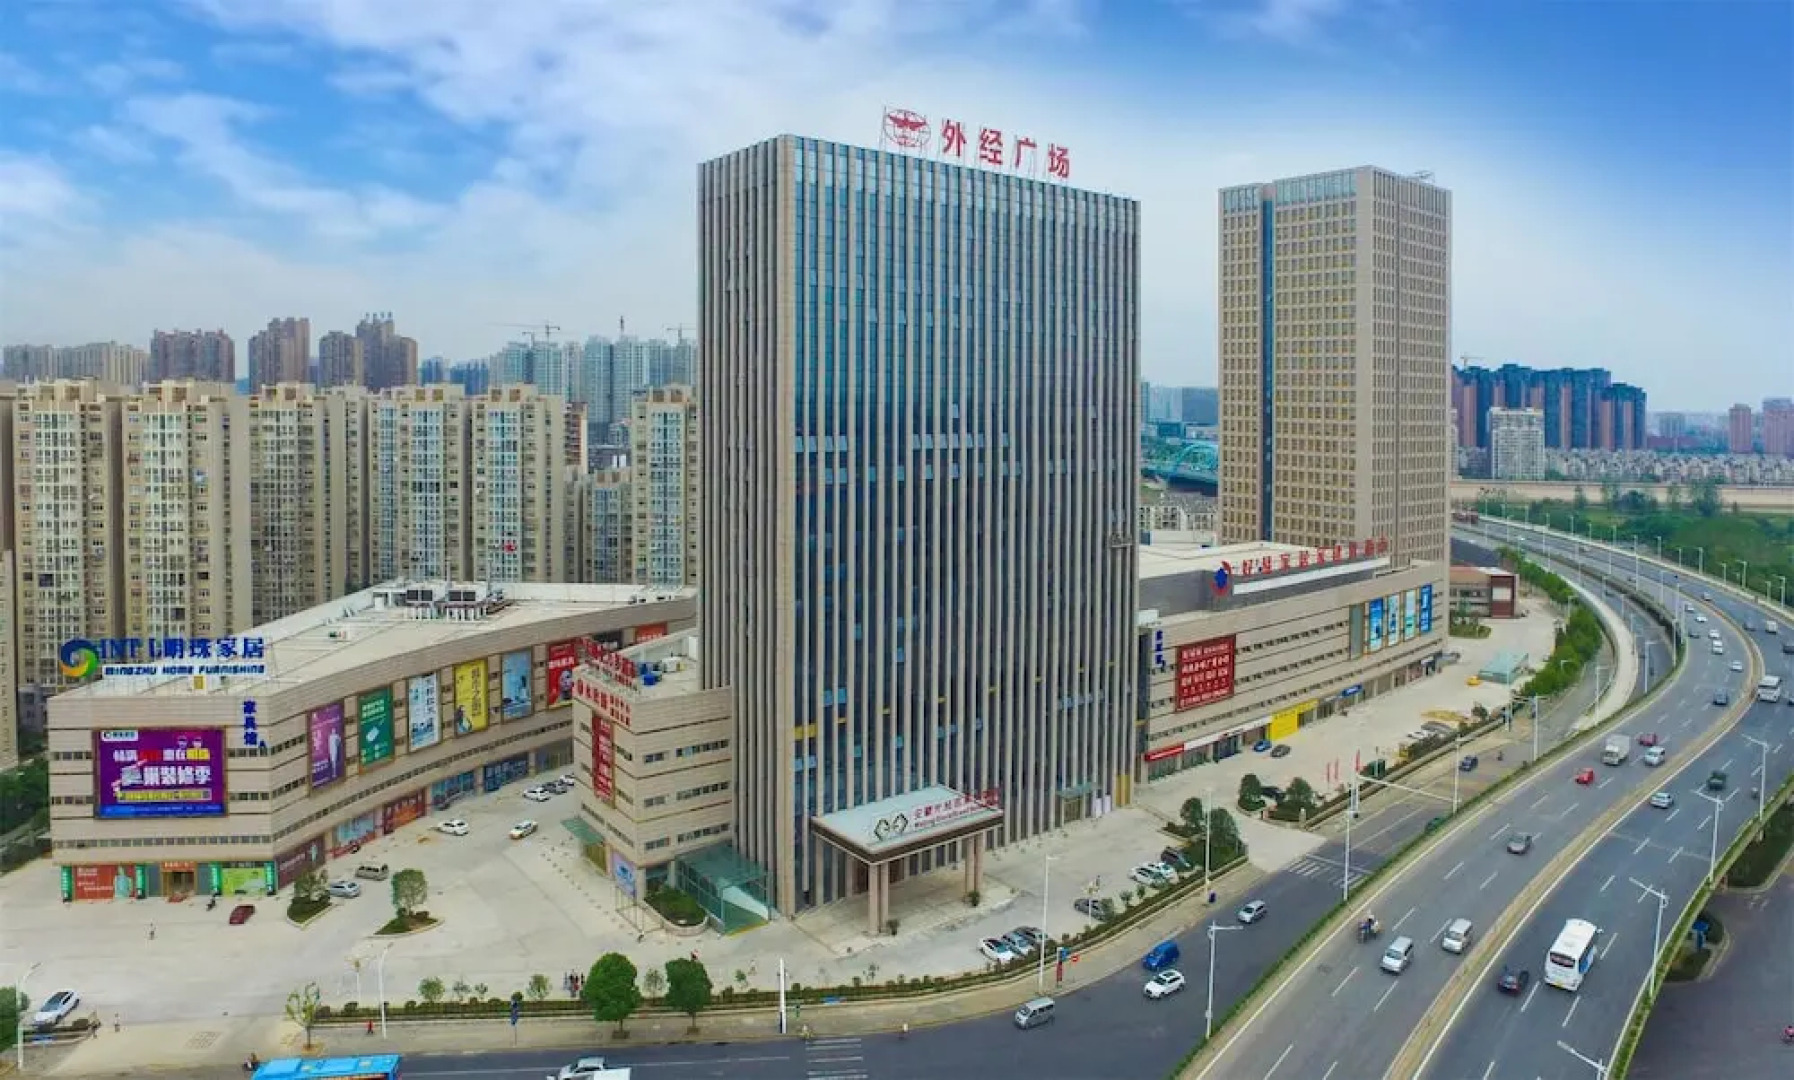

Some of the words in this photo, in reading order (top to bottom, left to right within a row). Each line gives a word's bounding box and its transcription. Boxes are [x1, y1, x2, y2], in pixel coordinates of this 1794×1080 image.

[941, 119, 1070, 178] 外经广场
[162, 666, 193, 675] HOME
[198, 665, 265, 675] FURNISHING
